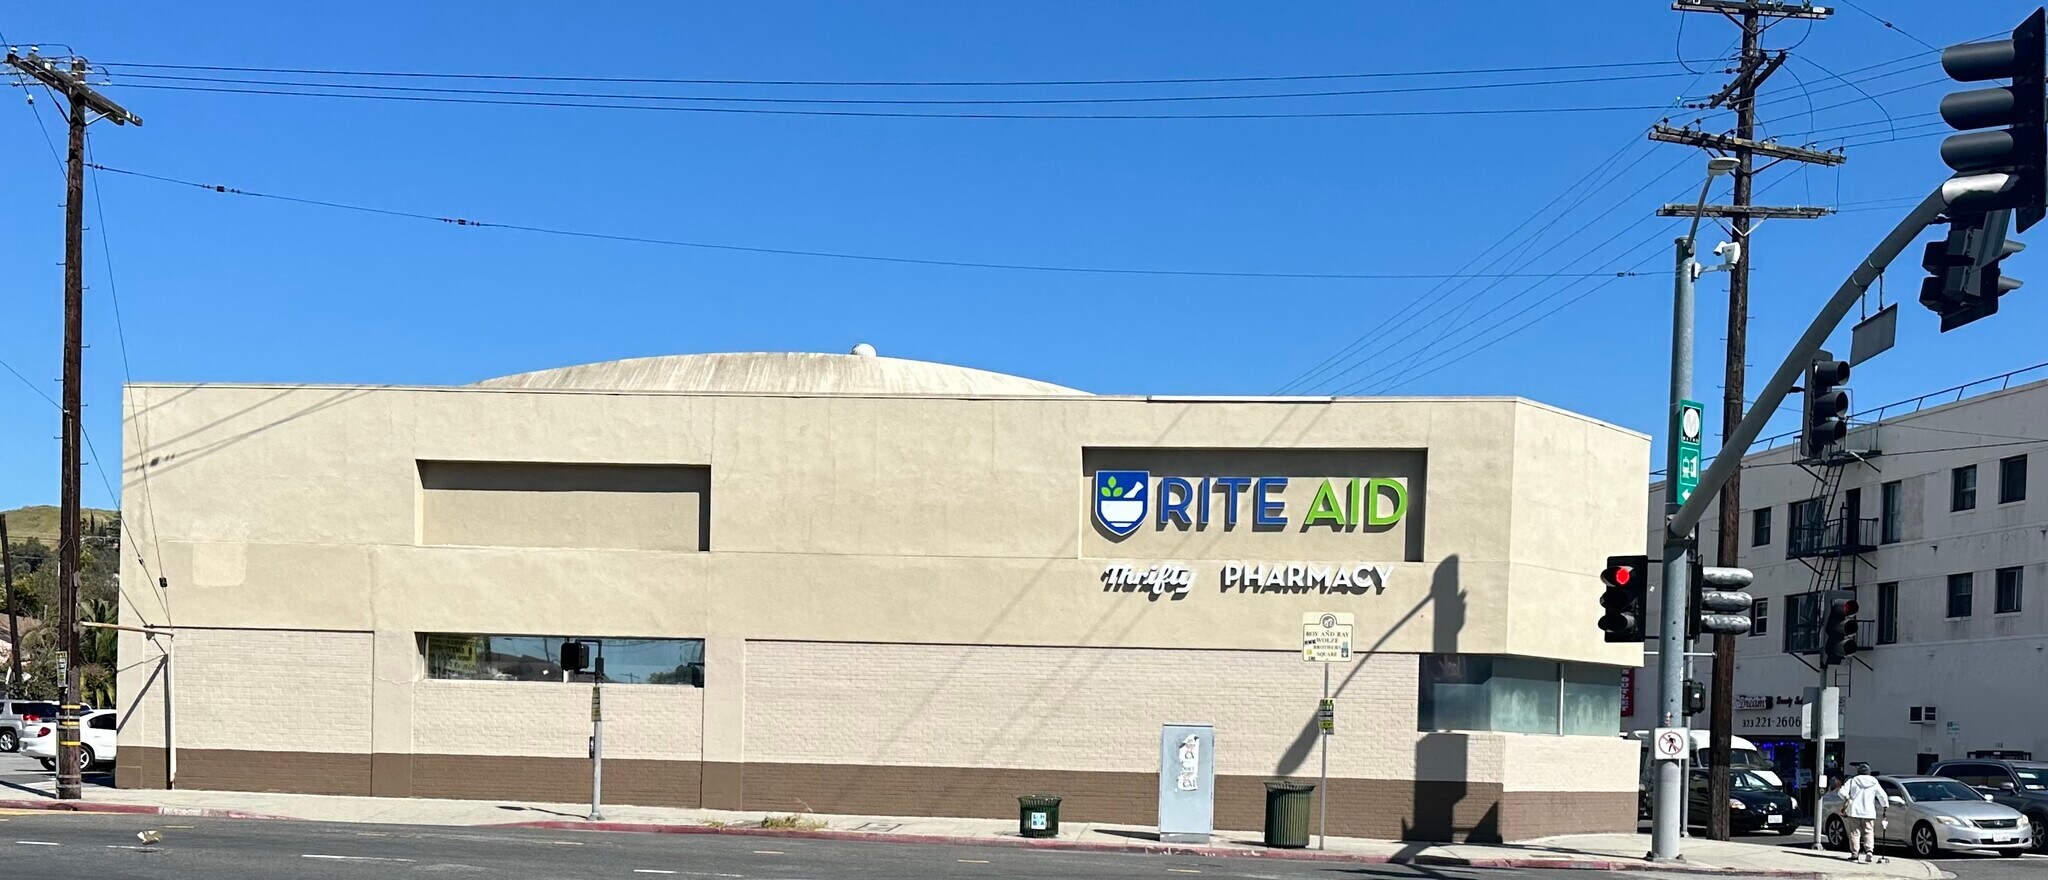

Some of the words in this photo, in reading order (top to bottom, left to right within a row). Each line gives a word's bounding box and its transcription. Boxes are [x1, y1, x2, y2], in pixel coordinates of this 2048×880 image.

[1160, 477, 1289, 525] RITE
[1304, 477, 1409, 525] AID
[1104, 564, 1196, 595] Thrifty
[1224, 564, 1395, 589] PHARMACY
[1755, 716, 1801, 727] 221-2606
